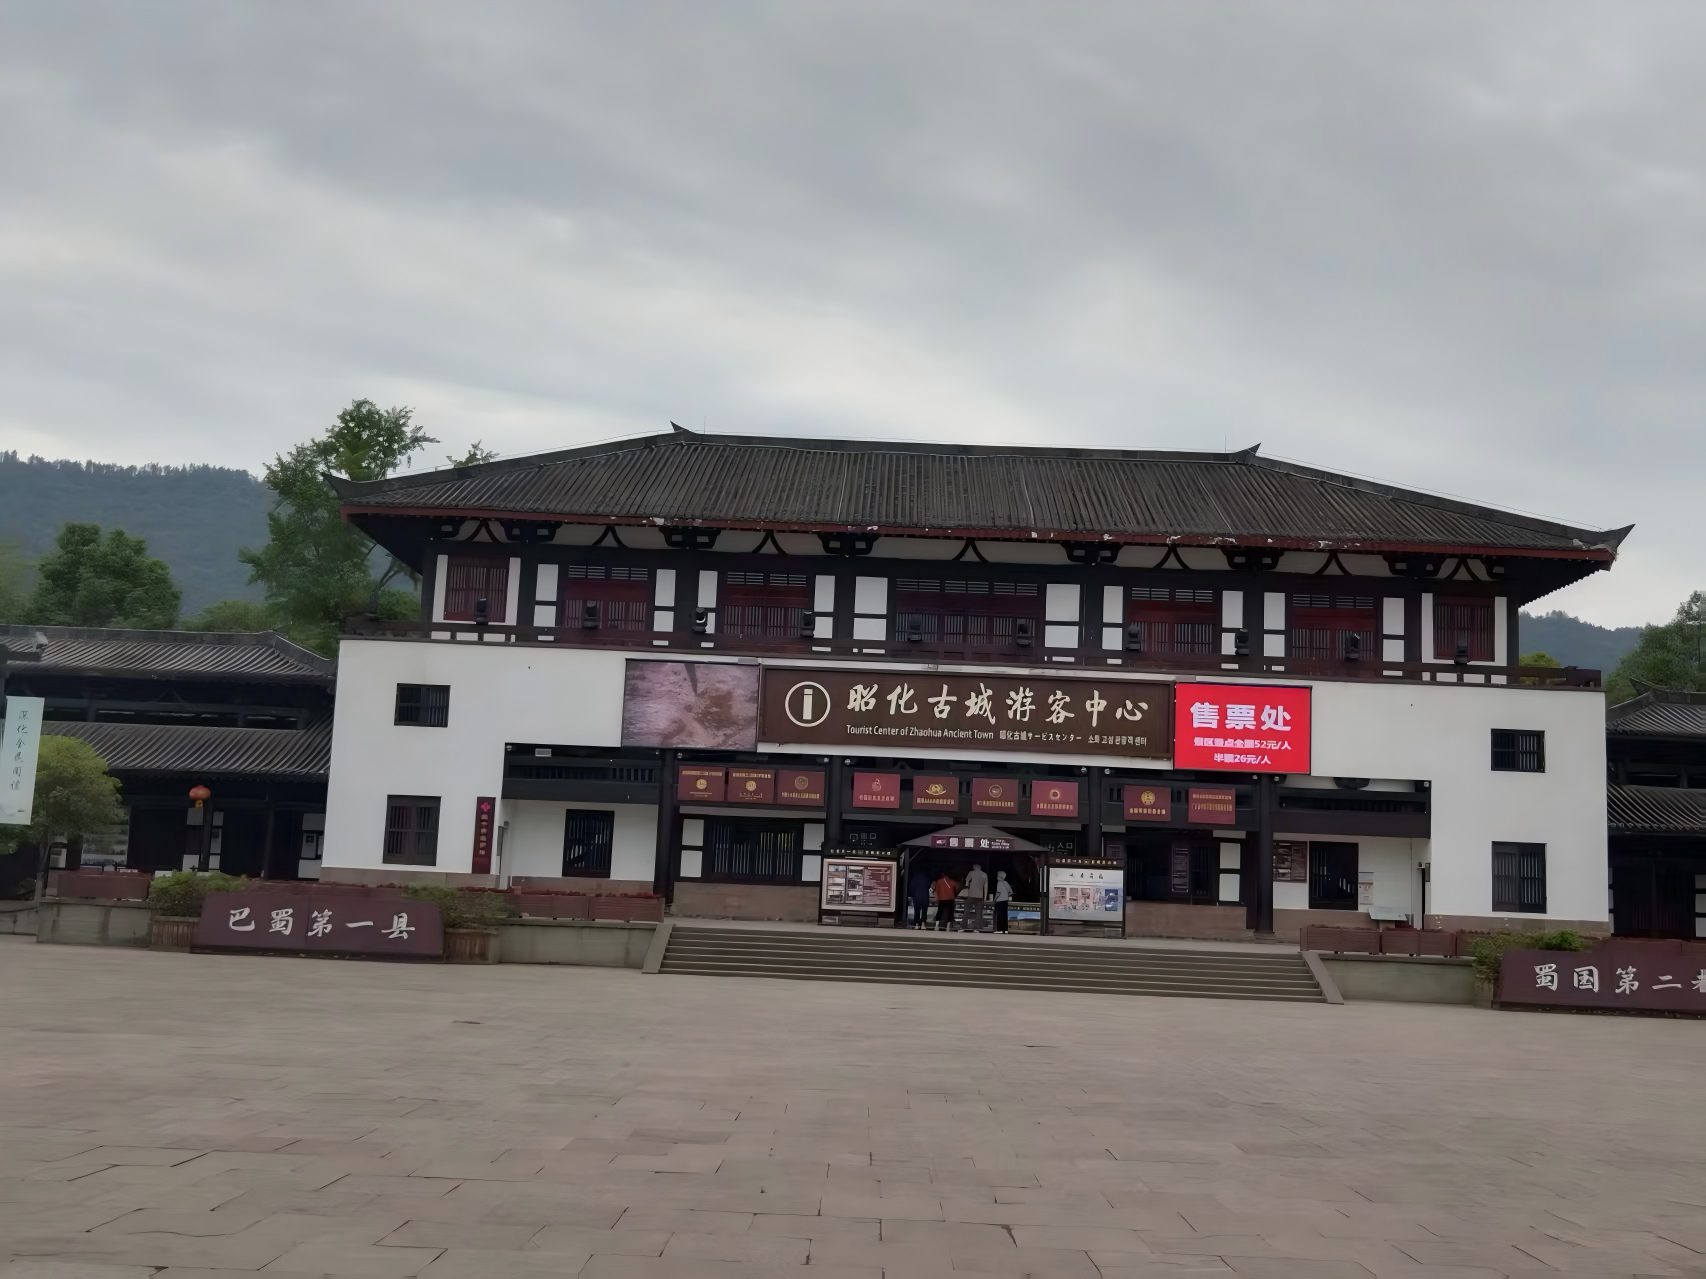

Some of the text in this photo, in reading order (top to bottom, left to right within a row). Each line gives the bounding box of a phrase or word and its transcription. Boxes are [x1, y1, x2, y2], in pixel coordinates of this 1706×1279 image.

[846, 683, 1149, 727] 昭化古城游客中心
[1190, 702, 1291, 731] 售票处
[846, 725, 994, 739] Tourist Center of Zhaohua Ancient Town
[1214, 753, 1272, 765] 半票26元/人
[229, 907, 416, 939] 巴蜀第一县
